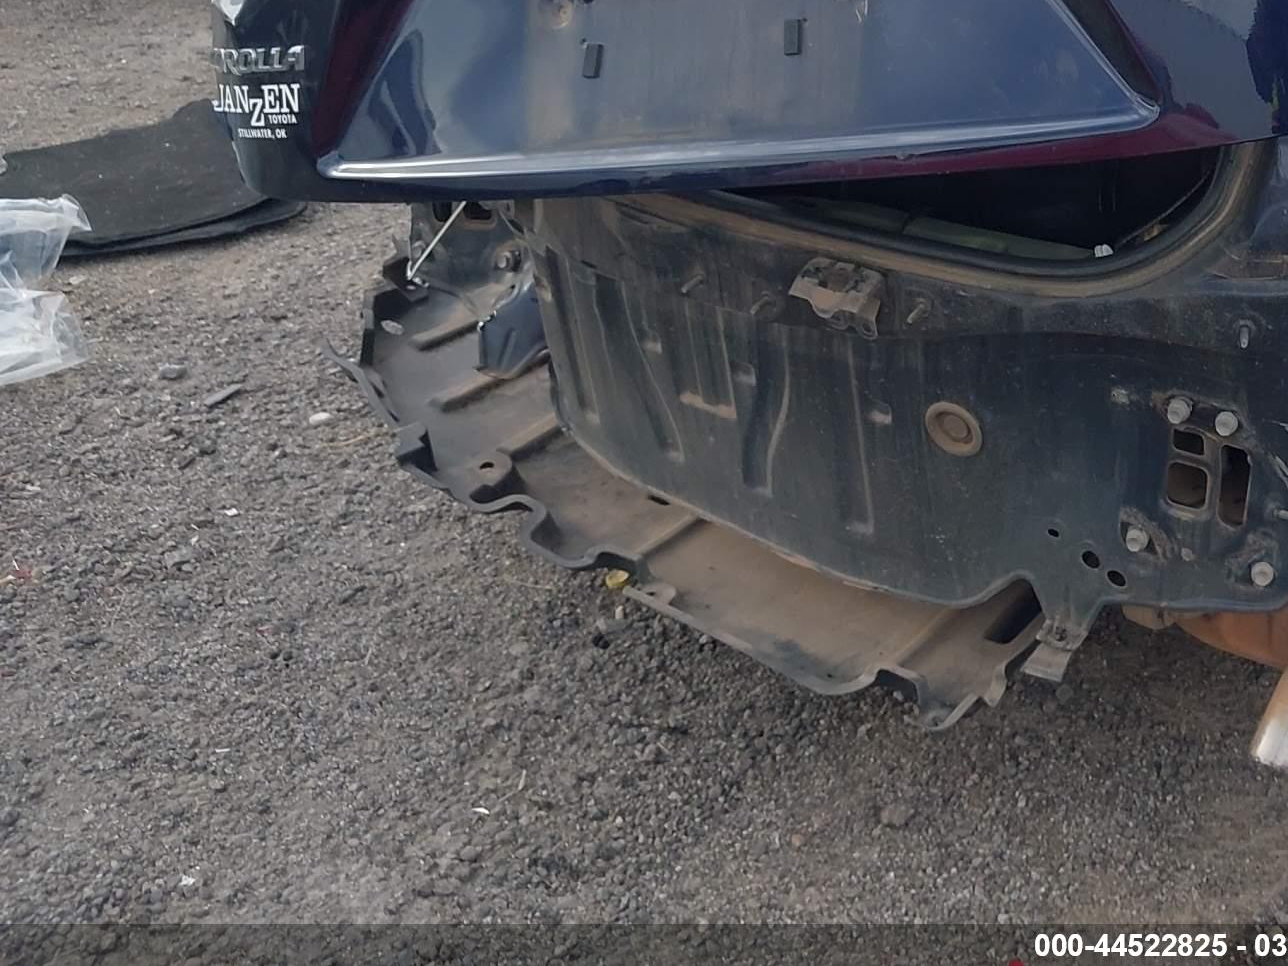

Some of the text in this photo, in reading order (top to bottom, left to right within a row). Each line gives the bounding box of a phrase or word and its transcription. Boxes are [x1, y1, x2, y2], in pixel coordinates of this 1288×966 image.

[212, 44, 305, 75] ROLLA
[212, 82, 300, 126] JANZEN
[268, 114, 298, 124] TOYOTA
[238, 128, 287, 139] STILLWATER, OK
